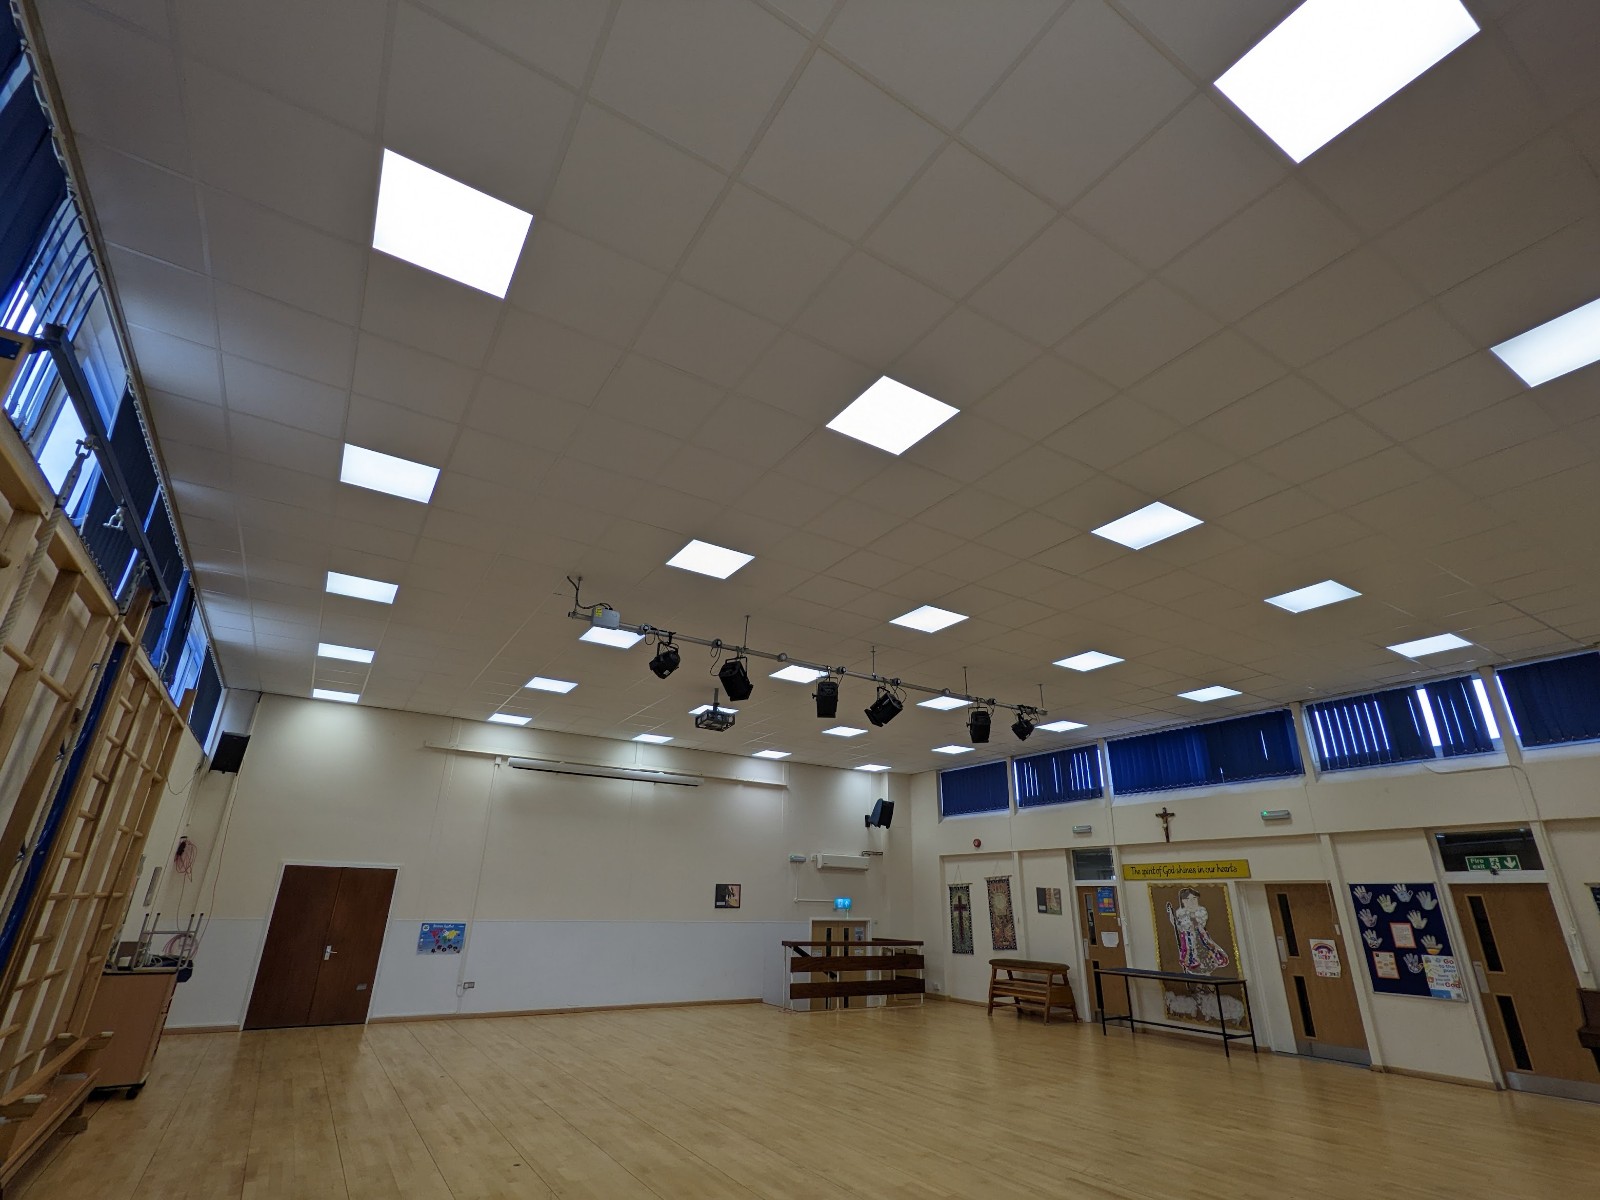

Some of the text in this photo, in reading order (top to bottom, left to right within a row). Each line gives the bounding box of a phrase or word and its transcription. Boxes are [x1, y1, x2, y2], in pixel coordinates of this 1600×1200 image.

[1131, 863, 1238, 877] The spirit of God shines in our hearts
